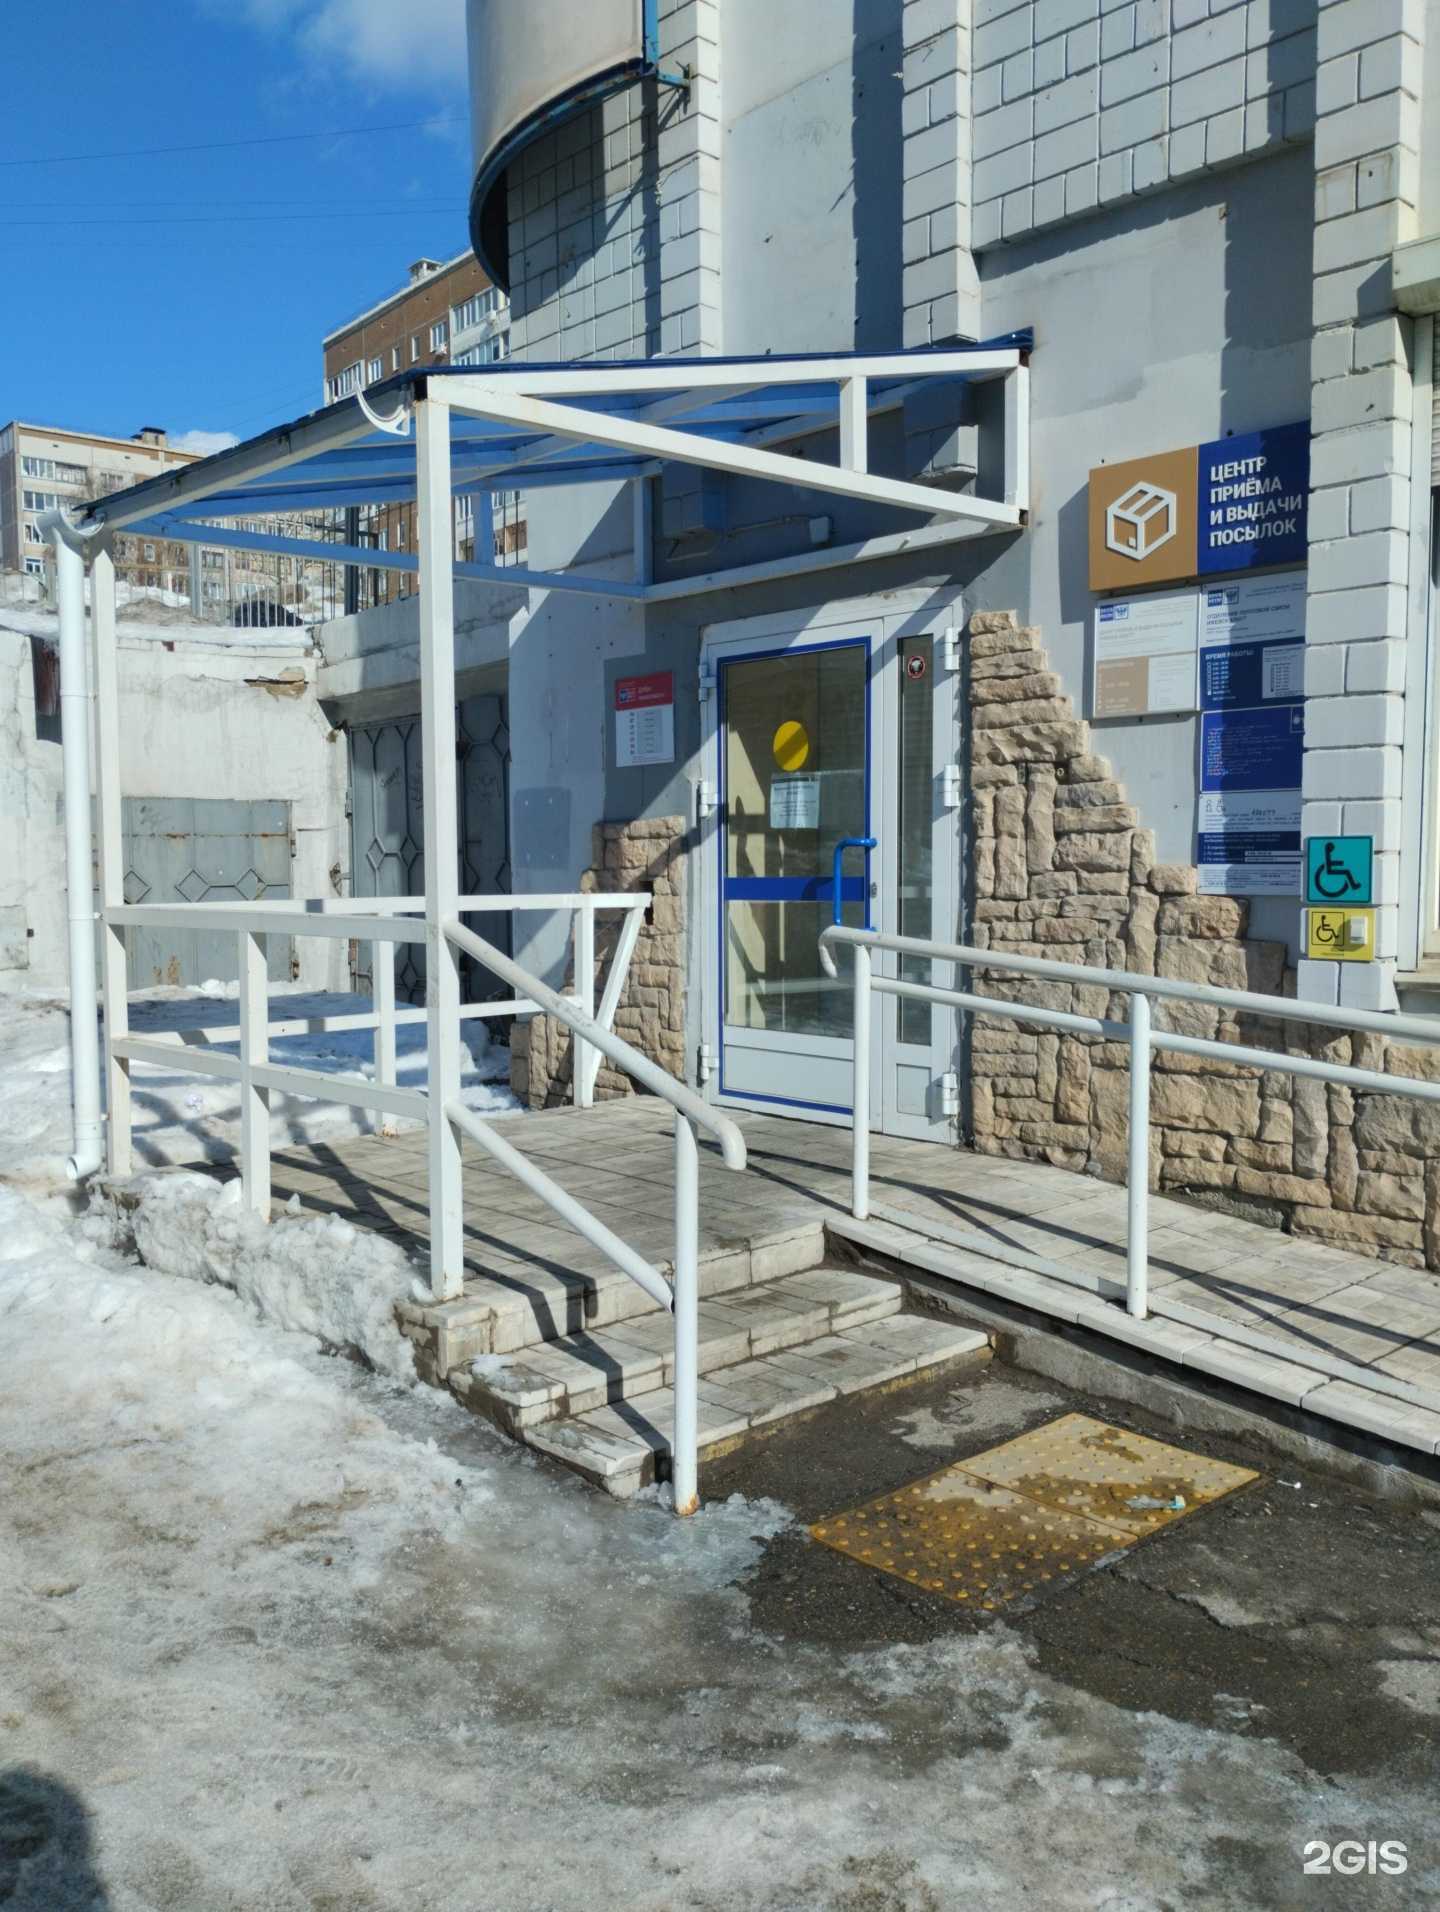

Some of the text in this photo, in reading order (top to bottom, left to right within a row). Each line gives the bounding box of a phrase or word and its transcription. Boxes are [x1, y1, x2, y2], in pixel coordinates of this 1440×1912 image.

[1210, 456, 1267, 483] ЦЕНТР
[1210, 476, 1283, 504] ПРИЁМА
[1210, 494, 1302, 526] И ВЫДАЧИ
[1210, 518, 1297, 547] ПОСЫЛОК
